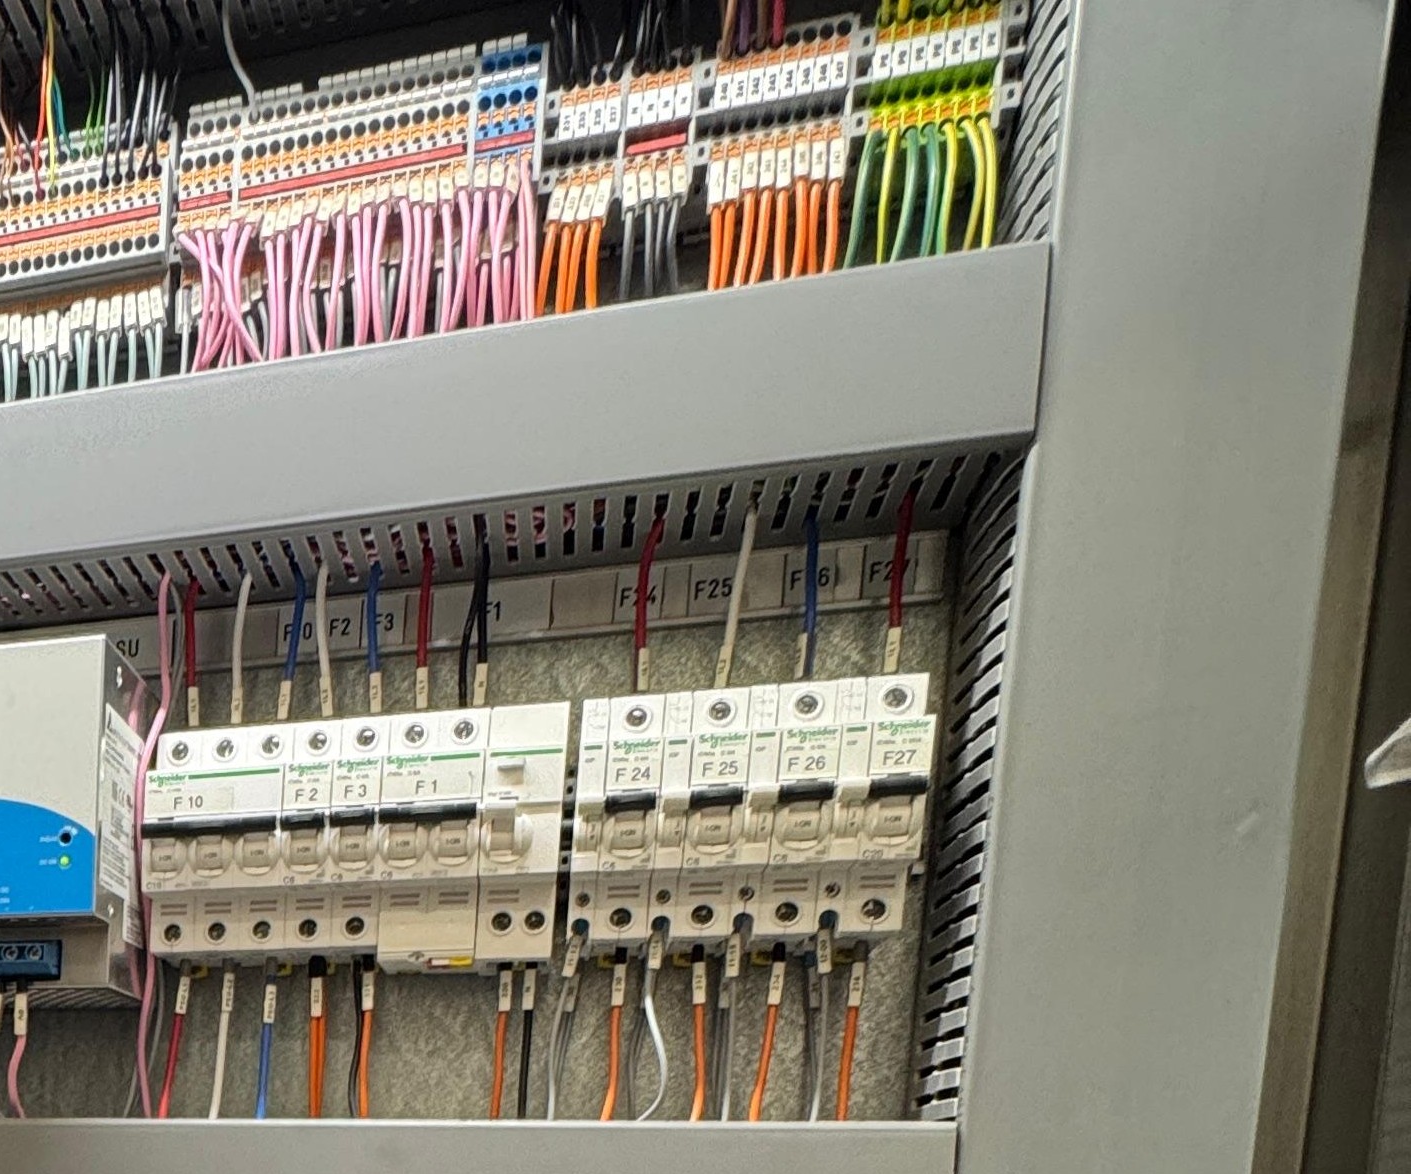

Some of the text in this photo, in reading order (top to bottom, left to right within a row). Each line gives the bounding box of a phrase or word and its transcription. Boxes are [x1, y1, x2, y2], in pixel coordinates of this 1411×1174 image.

[790, 567, 830, 590] F6
[620, 585, 658, 608] F4
[694, 576, 733, 600] F25
[329, 618, 351, 638] F2
[375, 612, 395, 632] F3
[283, 622, 313, 642] F0
[787, 756, 826, 772] F 26
[883, 749, 917, 766] F27
[615, 766, 651, 782] F 24
[702, 760, 739, 777] F 25
[295, 788, 319, 803] F 2
[344, 784, 368, 799] F 3
[415, 780, 426, 795] F
[173, 795, 204, 810] F 10
